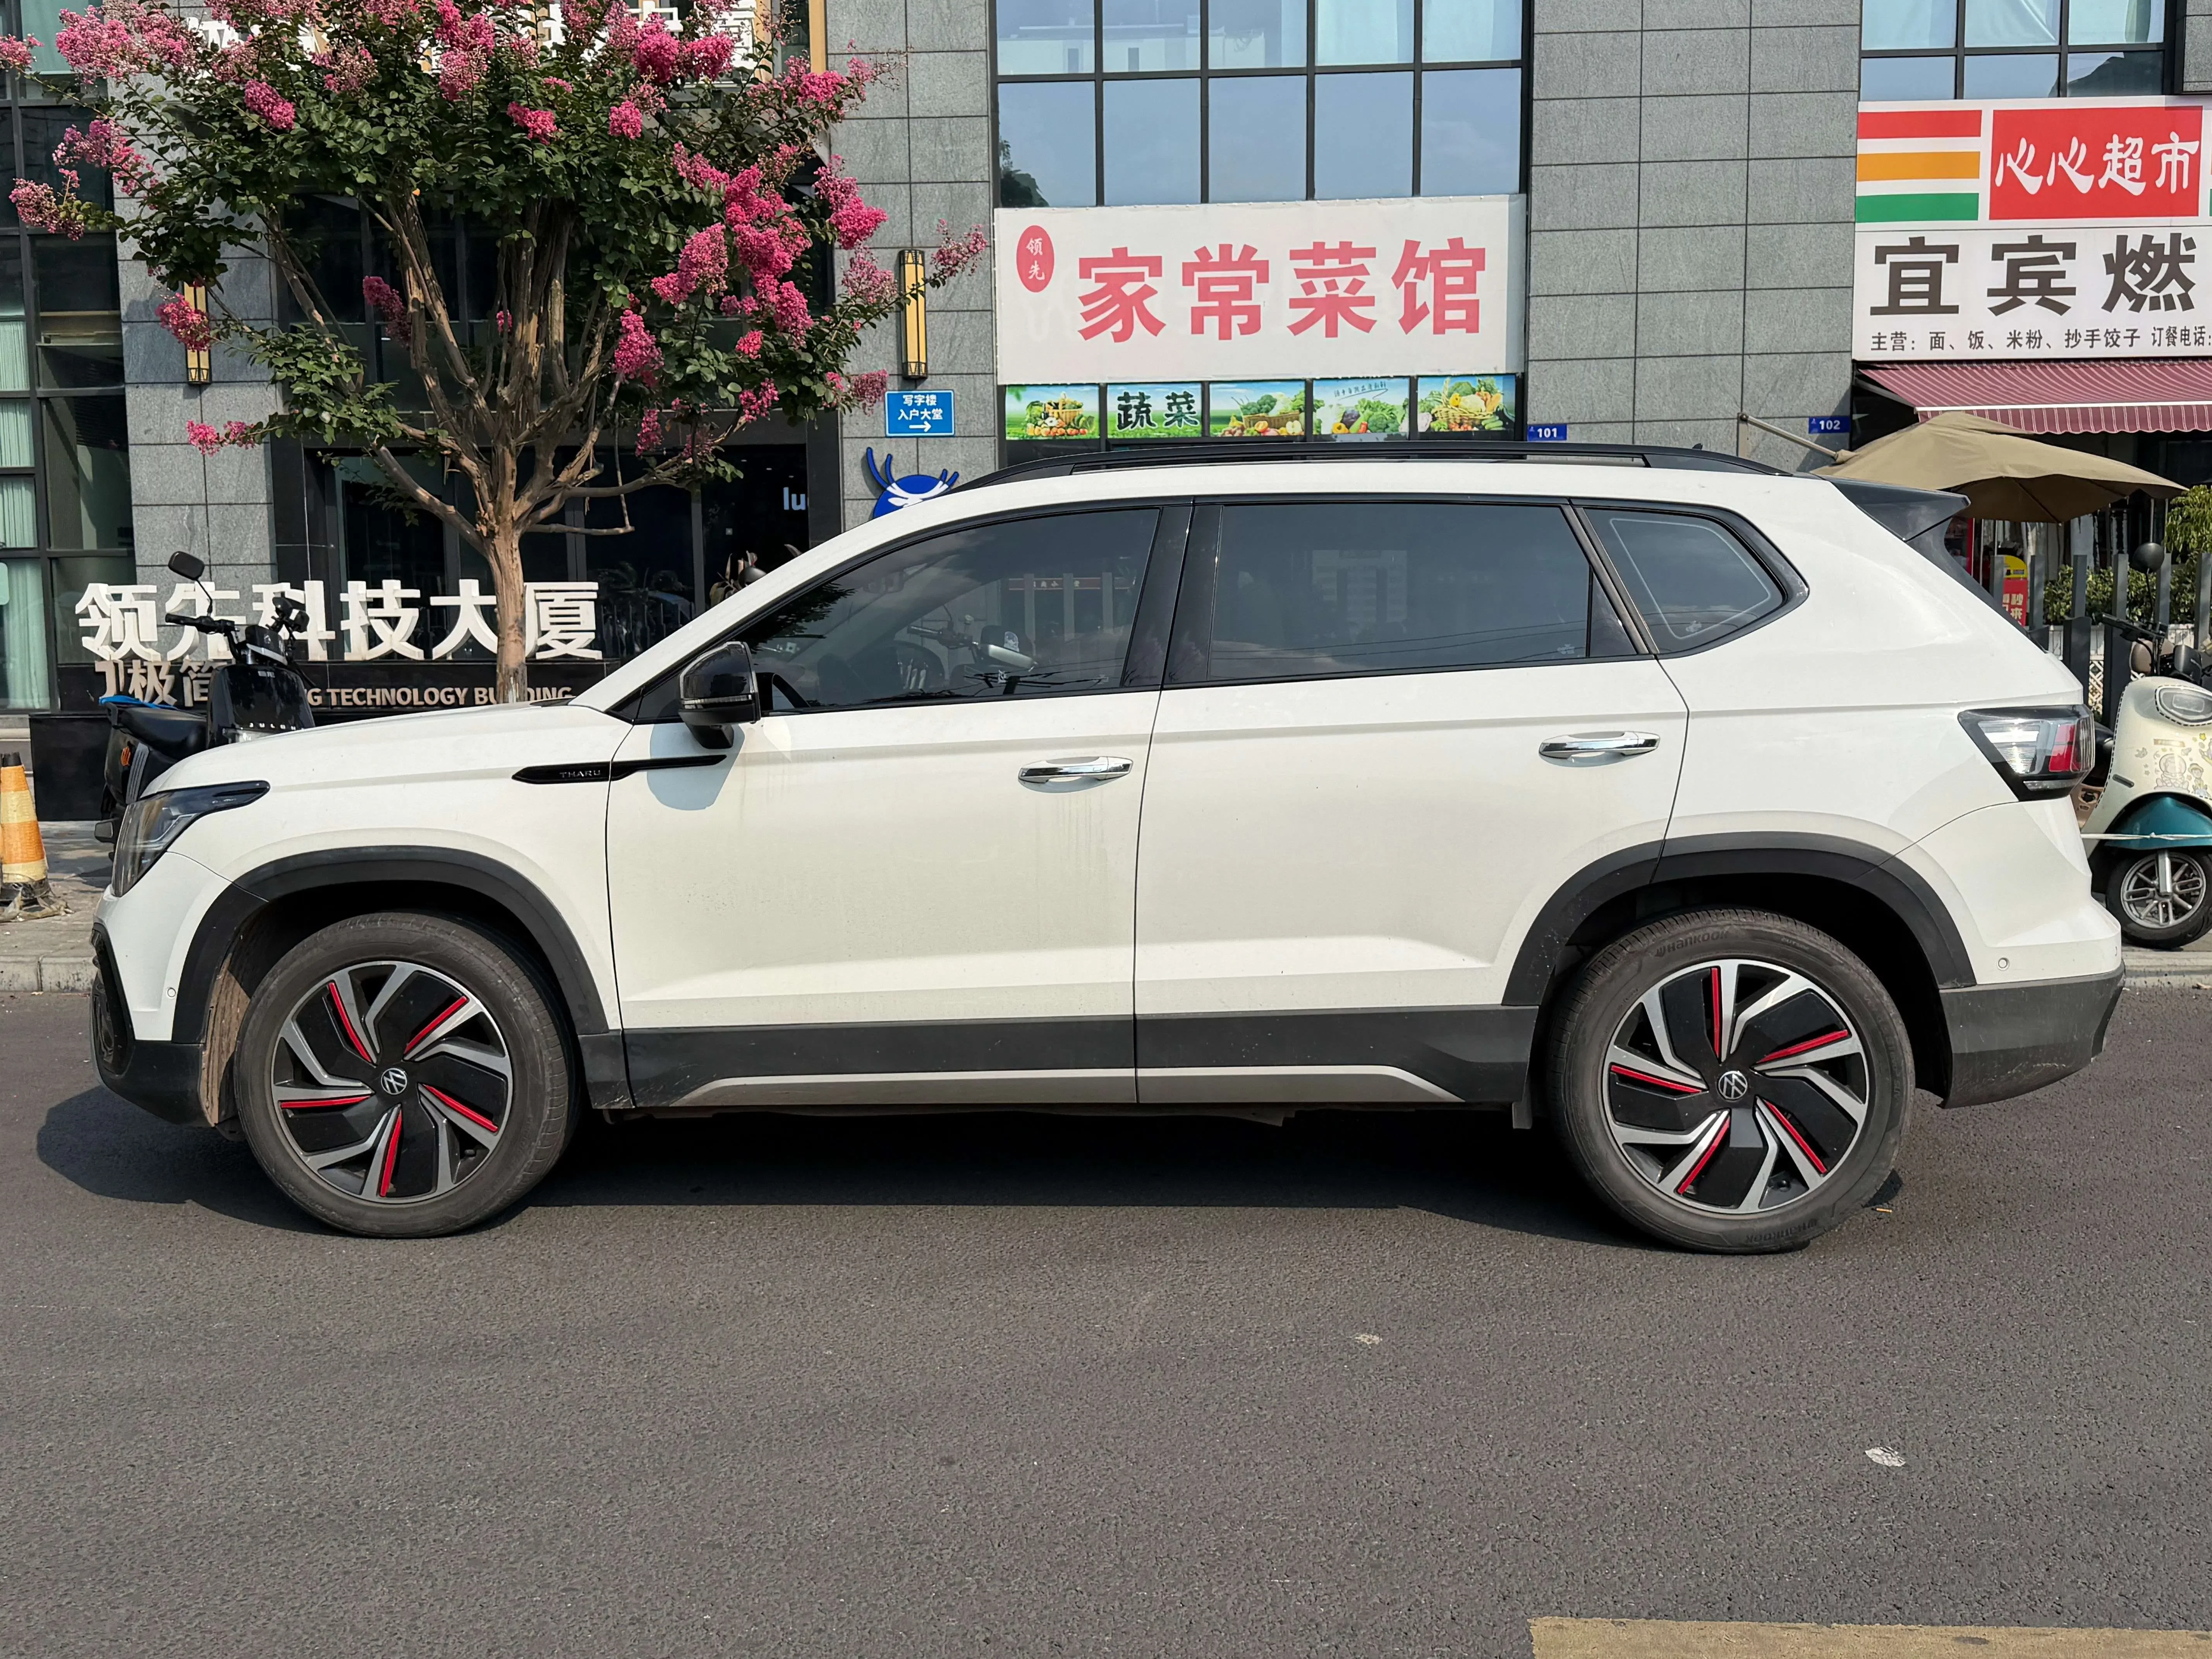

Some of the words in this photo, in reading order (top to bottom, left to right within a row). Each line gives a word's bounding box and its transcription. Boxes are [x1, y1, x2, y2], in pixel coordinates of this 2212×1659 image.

[1995, 131, 2200, 196] 心心超市
[1025, 237, 1045, 280] 领先
[1870, 232, 2197, 316] 宜宾燃
[1079, 237, 1486, 343] 家常菜馆
[898, 408, 943, 420] 入户大堂
[903, 394, 937, 406] 写字楼
[1117, 391, 1198, 430] 蔬菜
[1537, 428, 1557, 438] 101
[1819, 420, 1840, 430] 102
[75, 579, 603, 661] 领先科技大厦
[327, 687, 468, 706] TECHNOLOGY
[475, 687, 575, 705] BUDING
[560, 770, 600, 778] THARU
